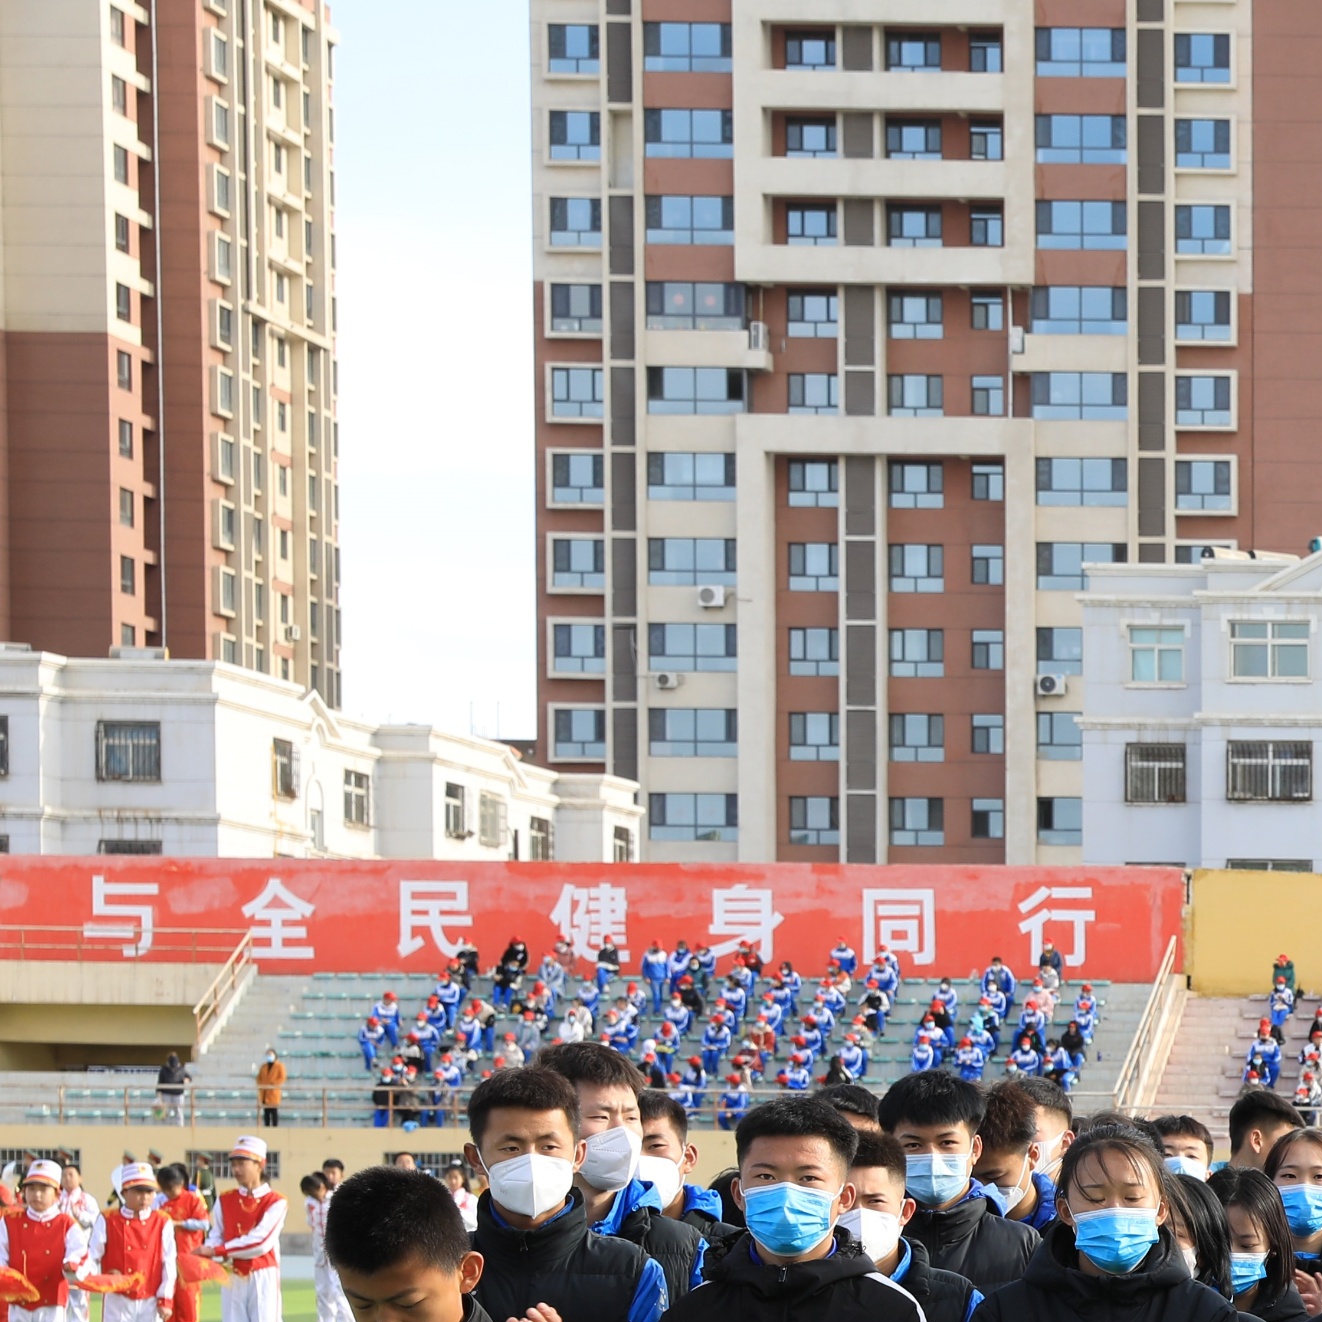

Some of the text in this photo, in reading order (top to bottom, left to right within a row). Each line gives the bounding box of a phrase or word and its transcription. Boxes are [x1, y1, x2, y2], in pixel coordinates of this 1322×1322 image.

[82, 875, 1096, 967] 与全民健身同行
